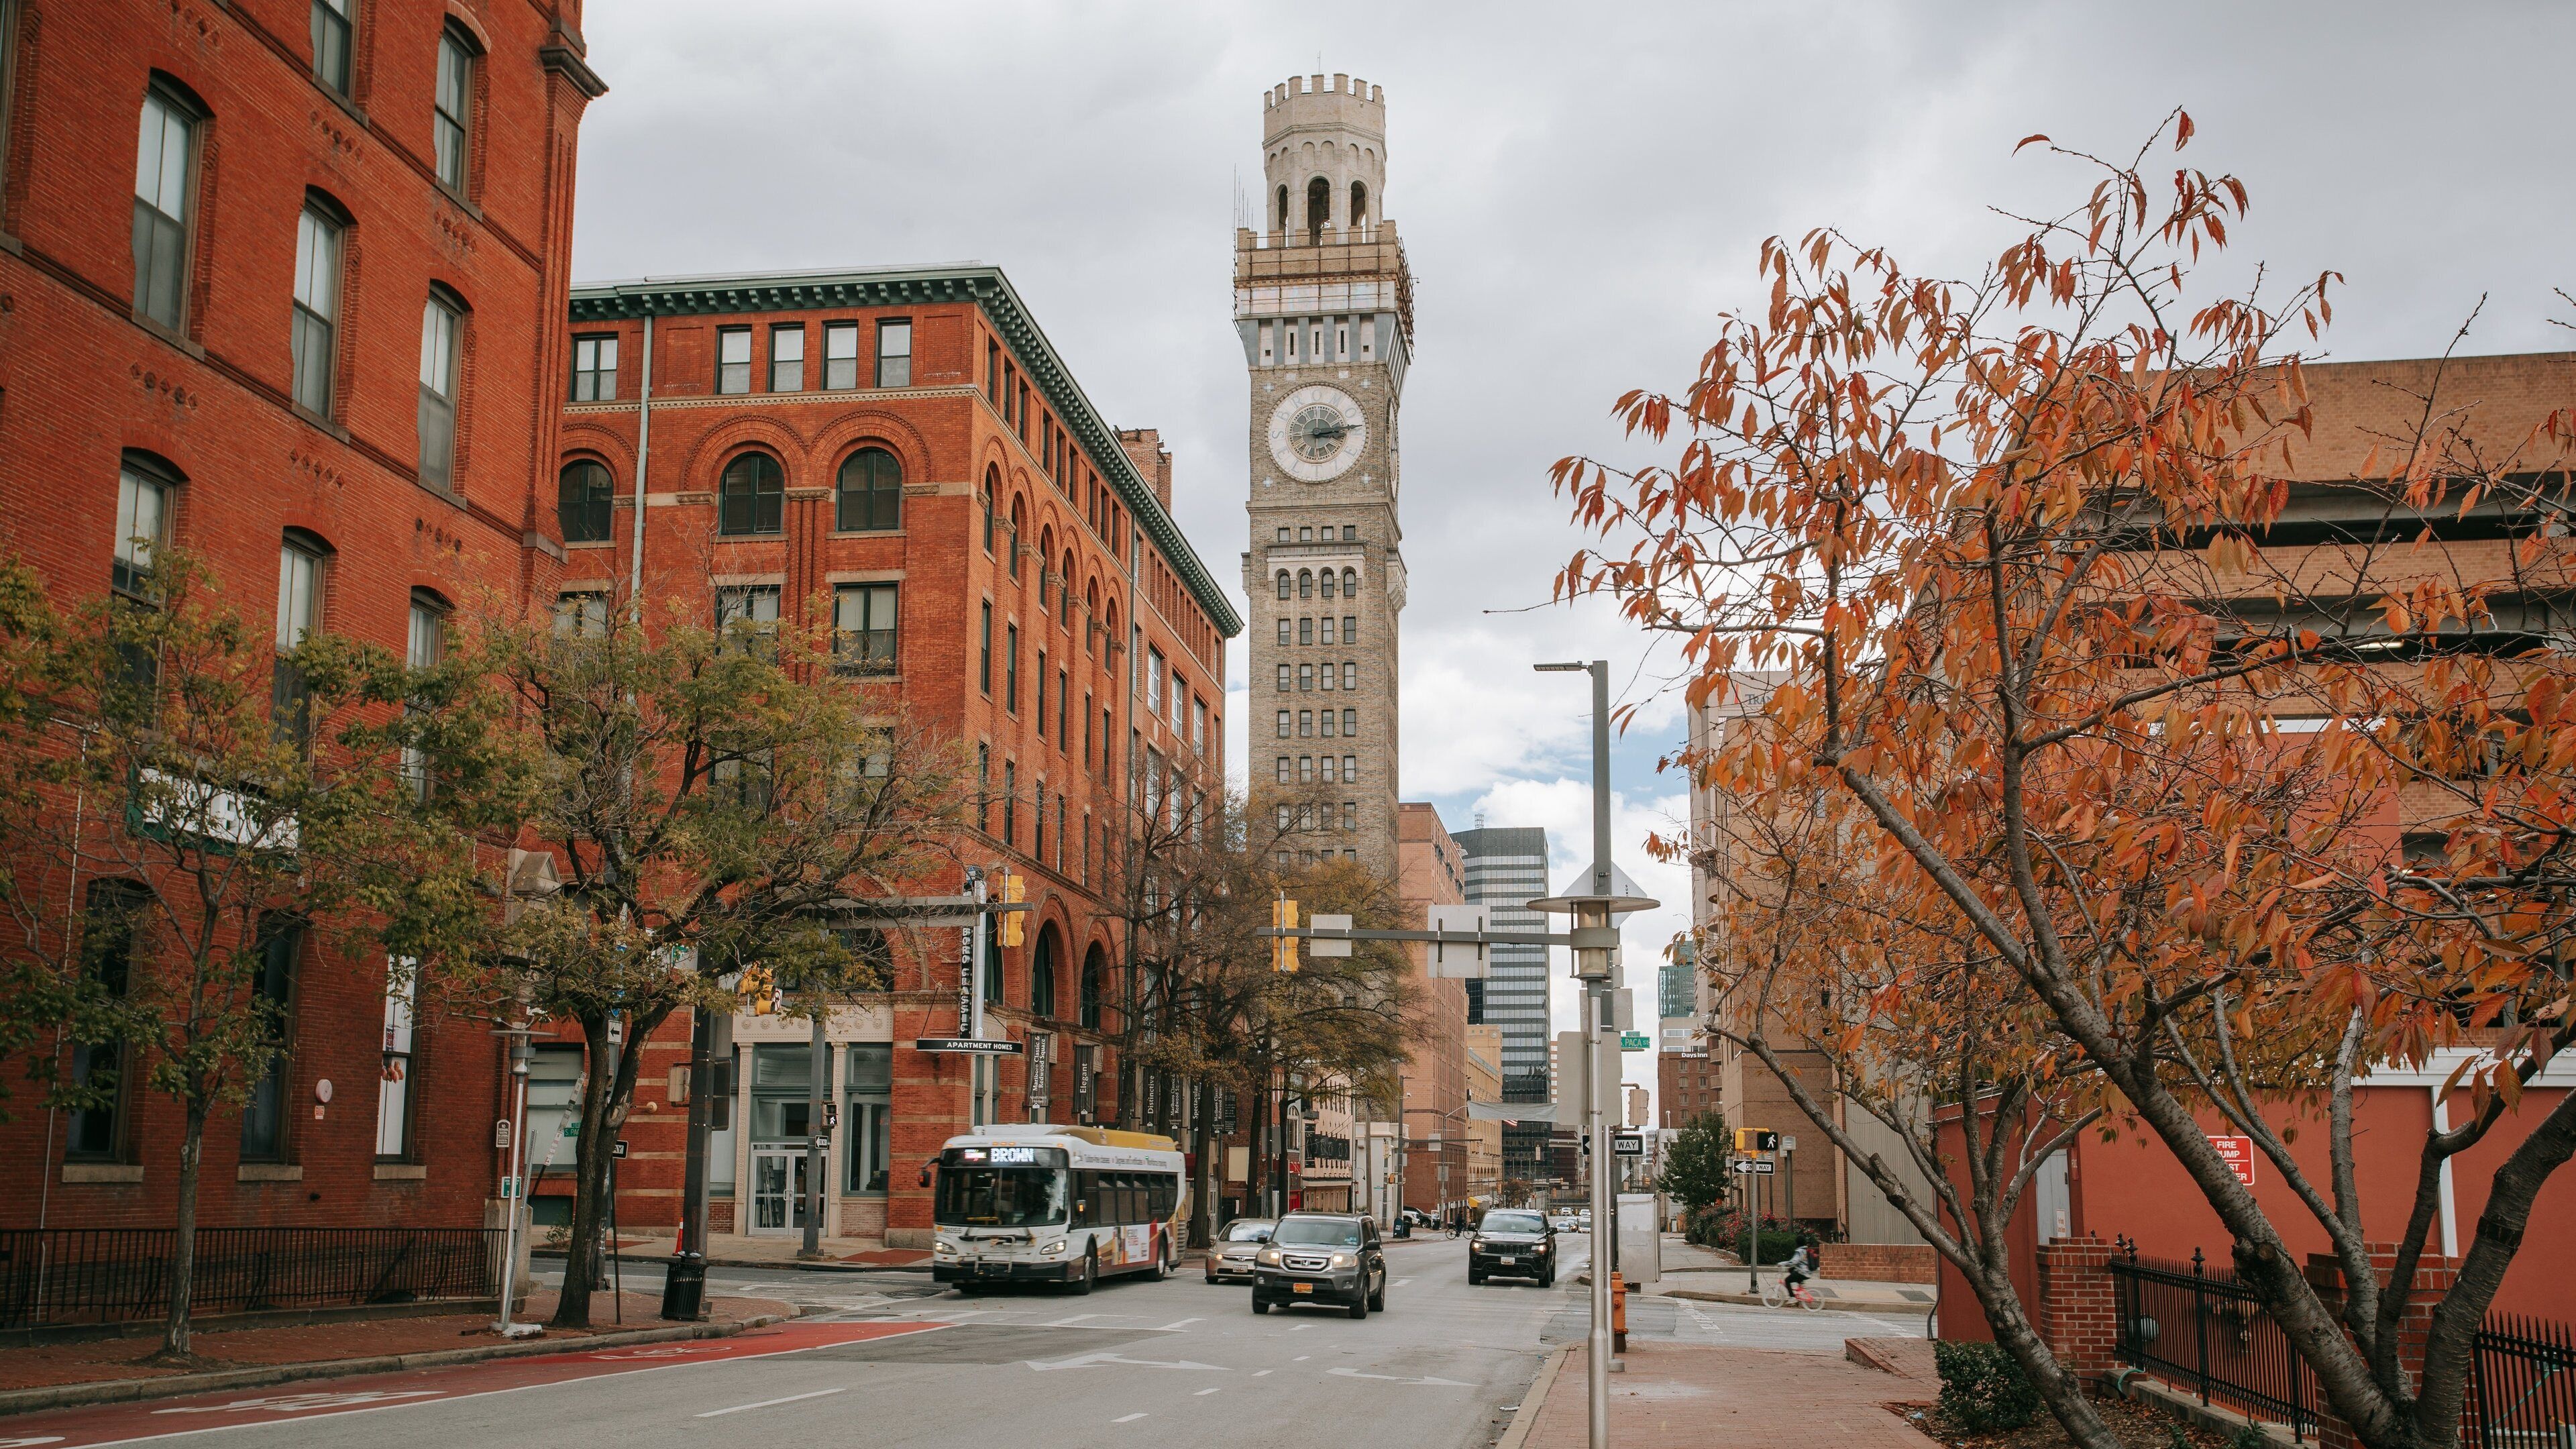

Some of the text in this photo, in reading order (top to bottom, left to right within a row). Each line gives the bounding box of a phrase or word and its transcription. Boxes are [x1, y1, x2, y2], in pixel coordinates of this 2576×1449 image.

[947, 1042, 991, 1050] APARTMENT
[1625, 1038, 1642, 1046] PACA
[1080, 1063, 1088, 1093] Elegant
[1617, 1141, 1637, 1149] WAY
[991, 1148, 1034, 1162] BROWN
